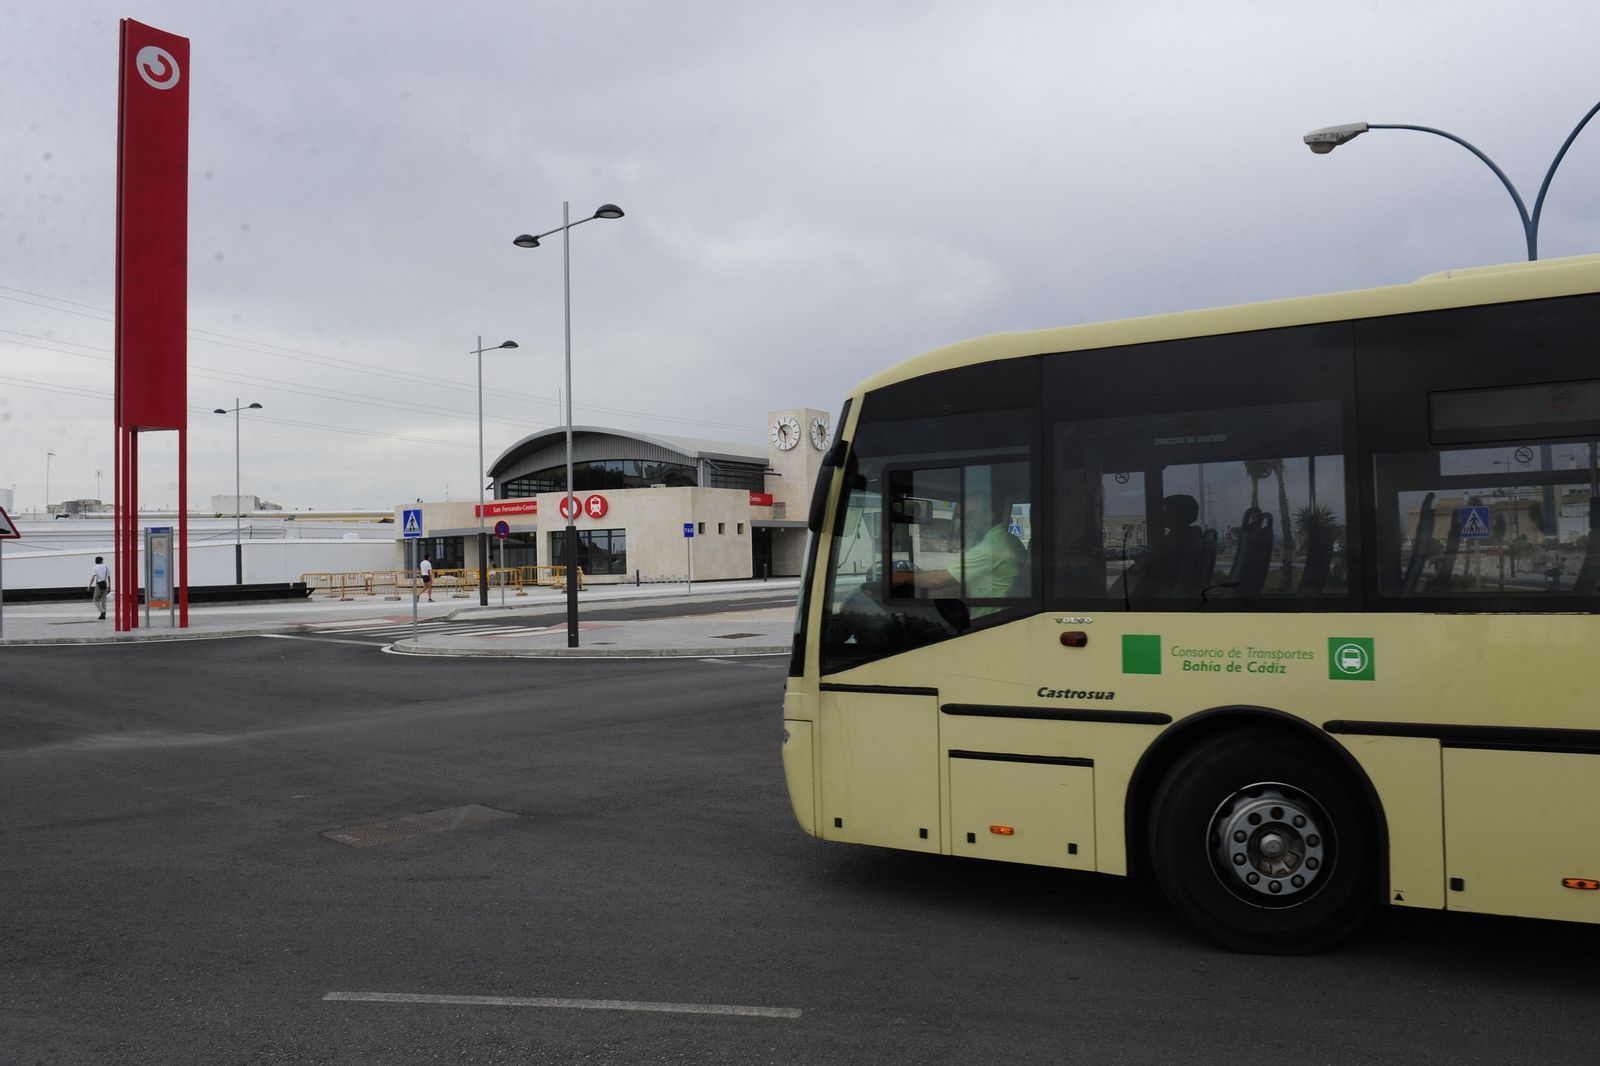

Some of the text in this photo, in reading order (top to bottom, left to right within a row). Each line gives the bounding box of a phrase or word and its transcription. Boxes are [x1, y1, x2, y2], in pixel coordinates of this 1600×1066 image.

[1171, 645, 1314, 660] Consorcio de Transportes
[1182, 660, 1287, 674] Bahía de Cádiz
[1037, 686, 1115, 700] Castrosua
